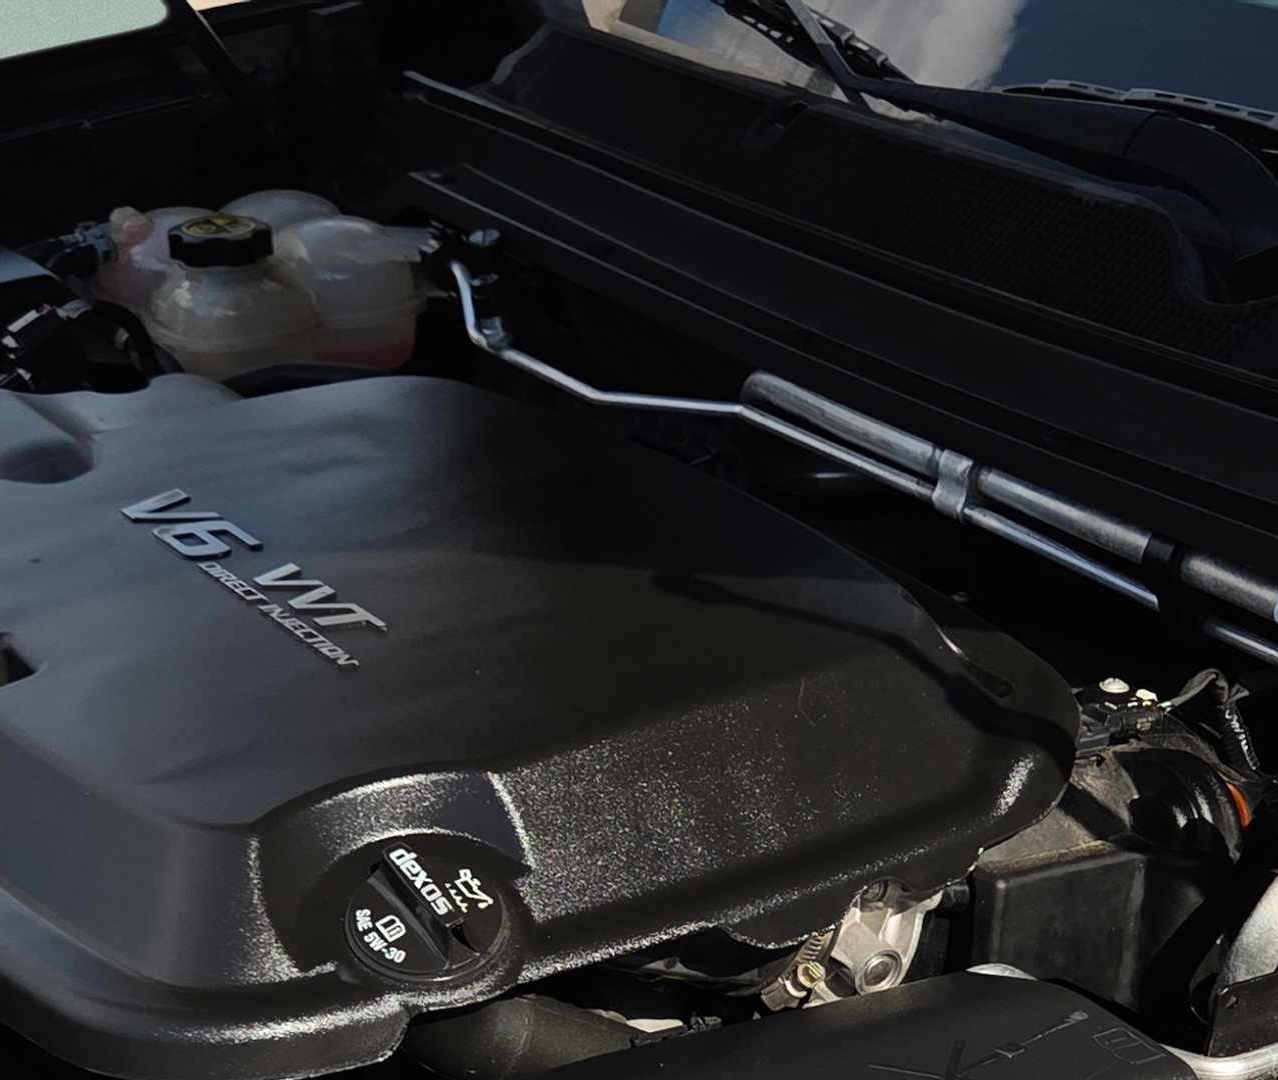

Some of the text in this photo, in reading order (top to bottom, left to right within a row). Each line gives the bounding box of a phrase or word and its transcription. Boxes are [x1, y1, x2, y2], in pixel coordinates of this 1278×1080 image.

[121, 488, 388, 632] V6 VVT
[197, 561, 360, 669] DIRECT INJECTION
[389, 848, 453, 916] dexos
[355, 908, 406, 964] SAE 5W-30
